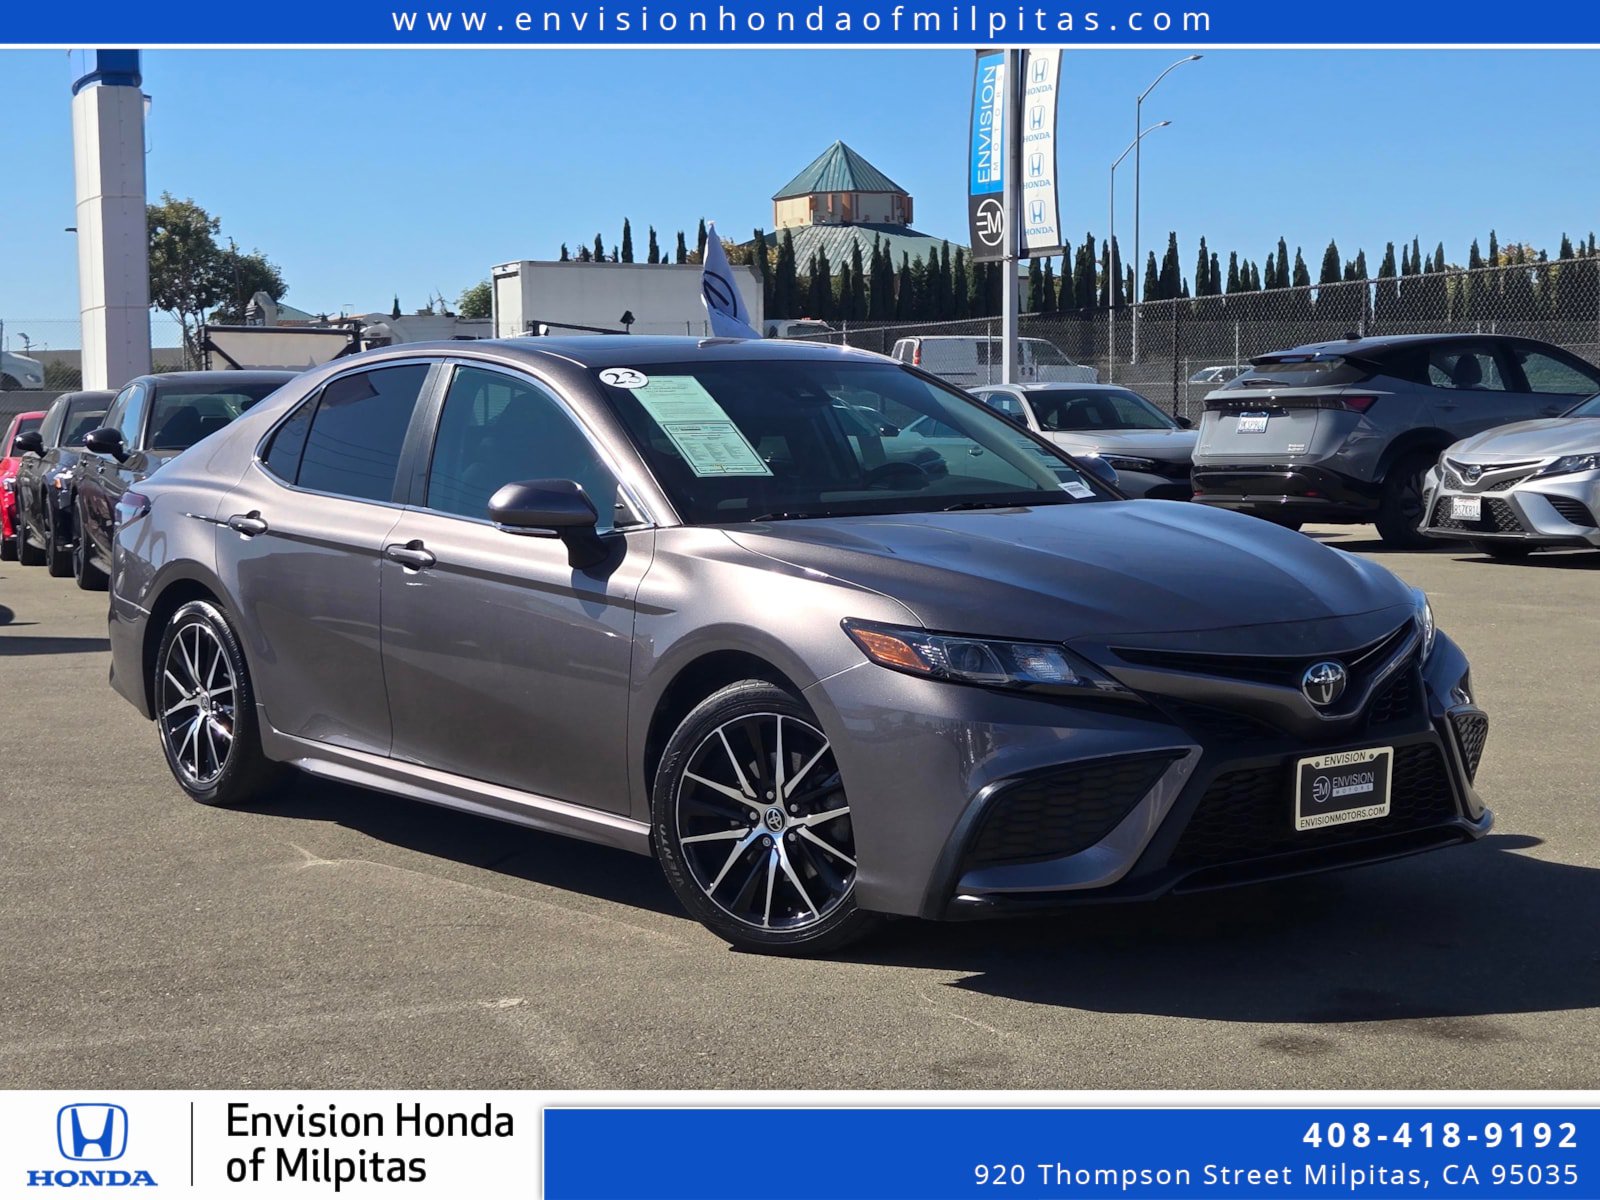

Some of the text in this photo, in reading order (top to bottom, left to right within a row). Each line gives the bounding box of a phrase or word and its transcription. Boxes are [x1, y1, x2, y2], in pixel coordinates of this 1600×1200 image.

[1025, 84, 1053, 96] HONDA
[977, 65, 996, 184] ENVISION
[1023, 131, 1051, 143] HONDA
[1023, 179, 1052, 190] HONDA
[1024, 226, 1054, 237] HONDA
[604, 371, 642, 385] 23
[1324, 752, 1366, 766] ENVISION
[1333, 772, 1374, 787] ENVISION
[1300, 807, 1385, 827] ENVISIONMOTORS.COM
